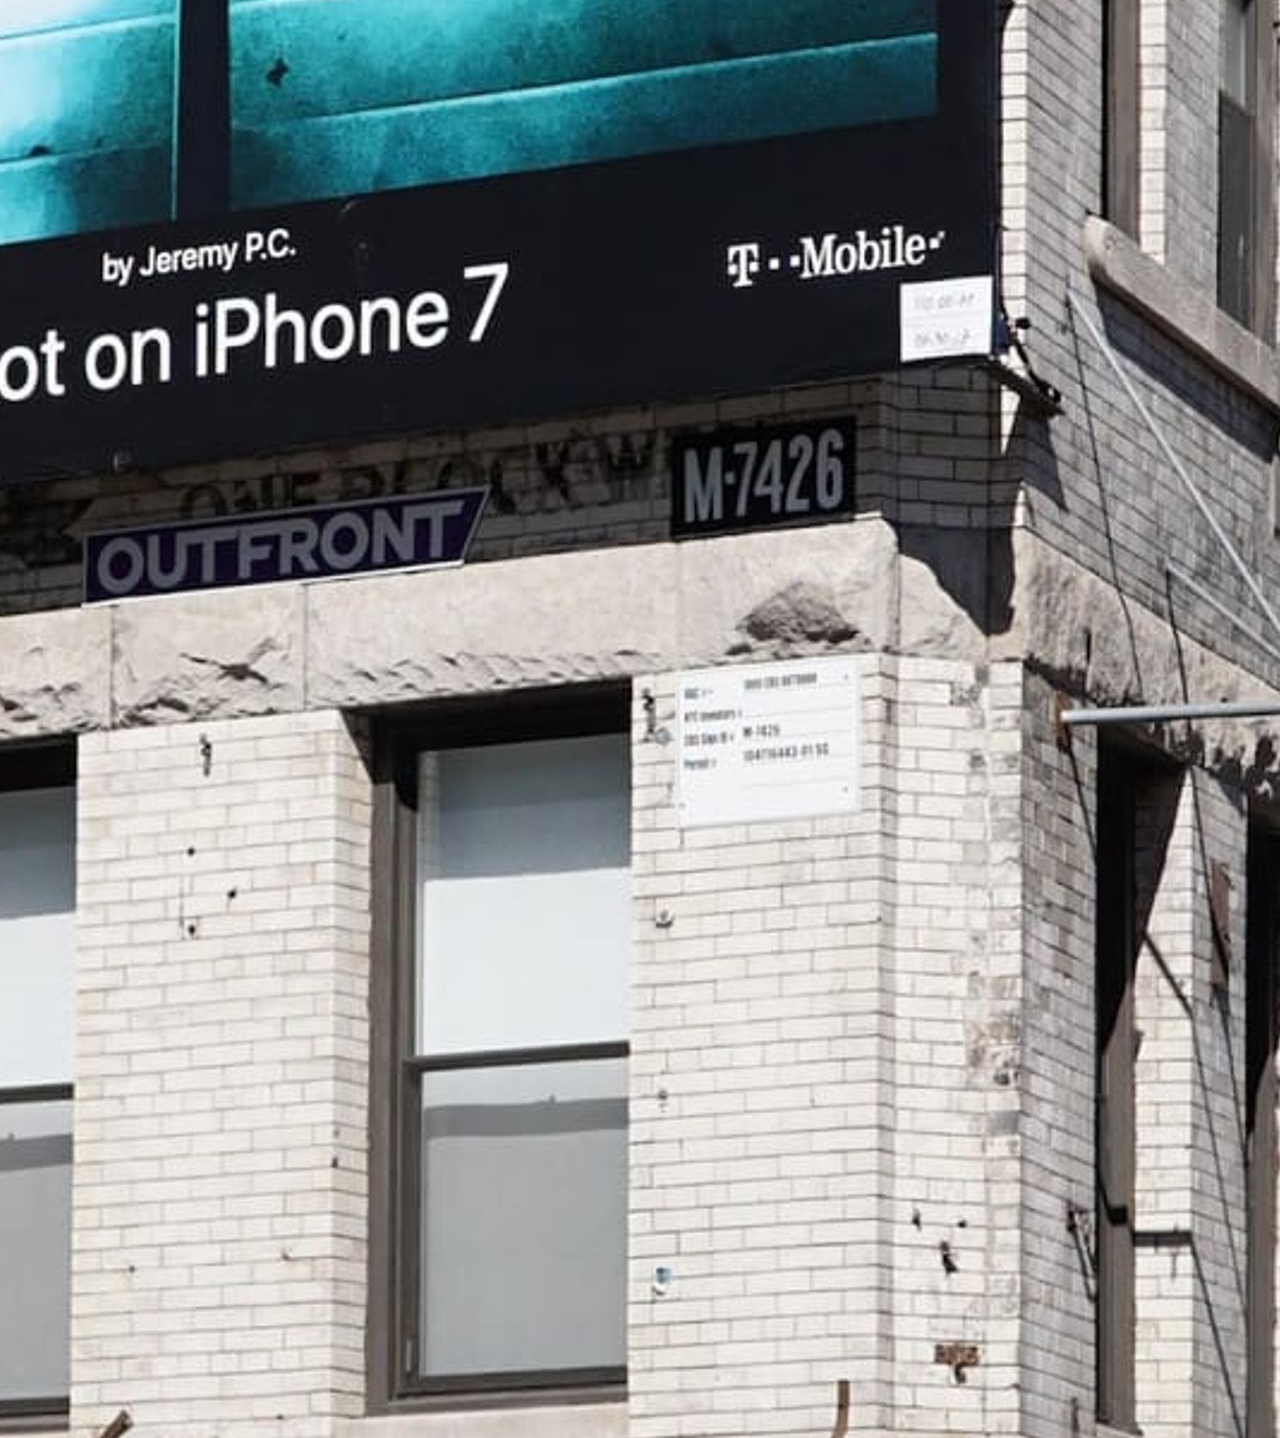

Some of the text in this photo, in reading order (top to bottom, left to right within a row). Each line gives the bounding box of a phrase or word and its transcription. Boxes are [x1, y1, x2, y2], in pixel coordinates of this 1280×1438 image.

[102, 227, 297, 287] by Jeremy P.C.
[84, 327, 171, 391] on
[194, 288, 449, 378] iPhone
[462, 262, 510, 343] 7
[96, 499, 465, 595] OUTFRONT
